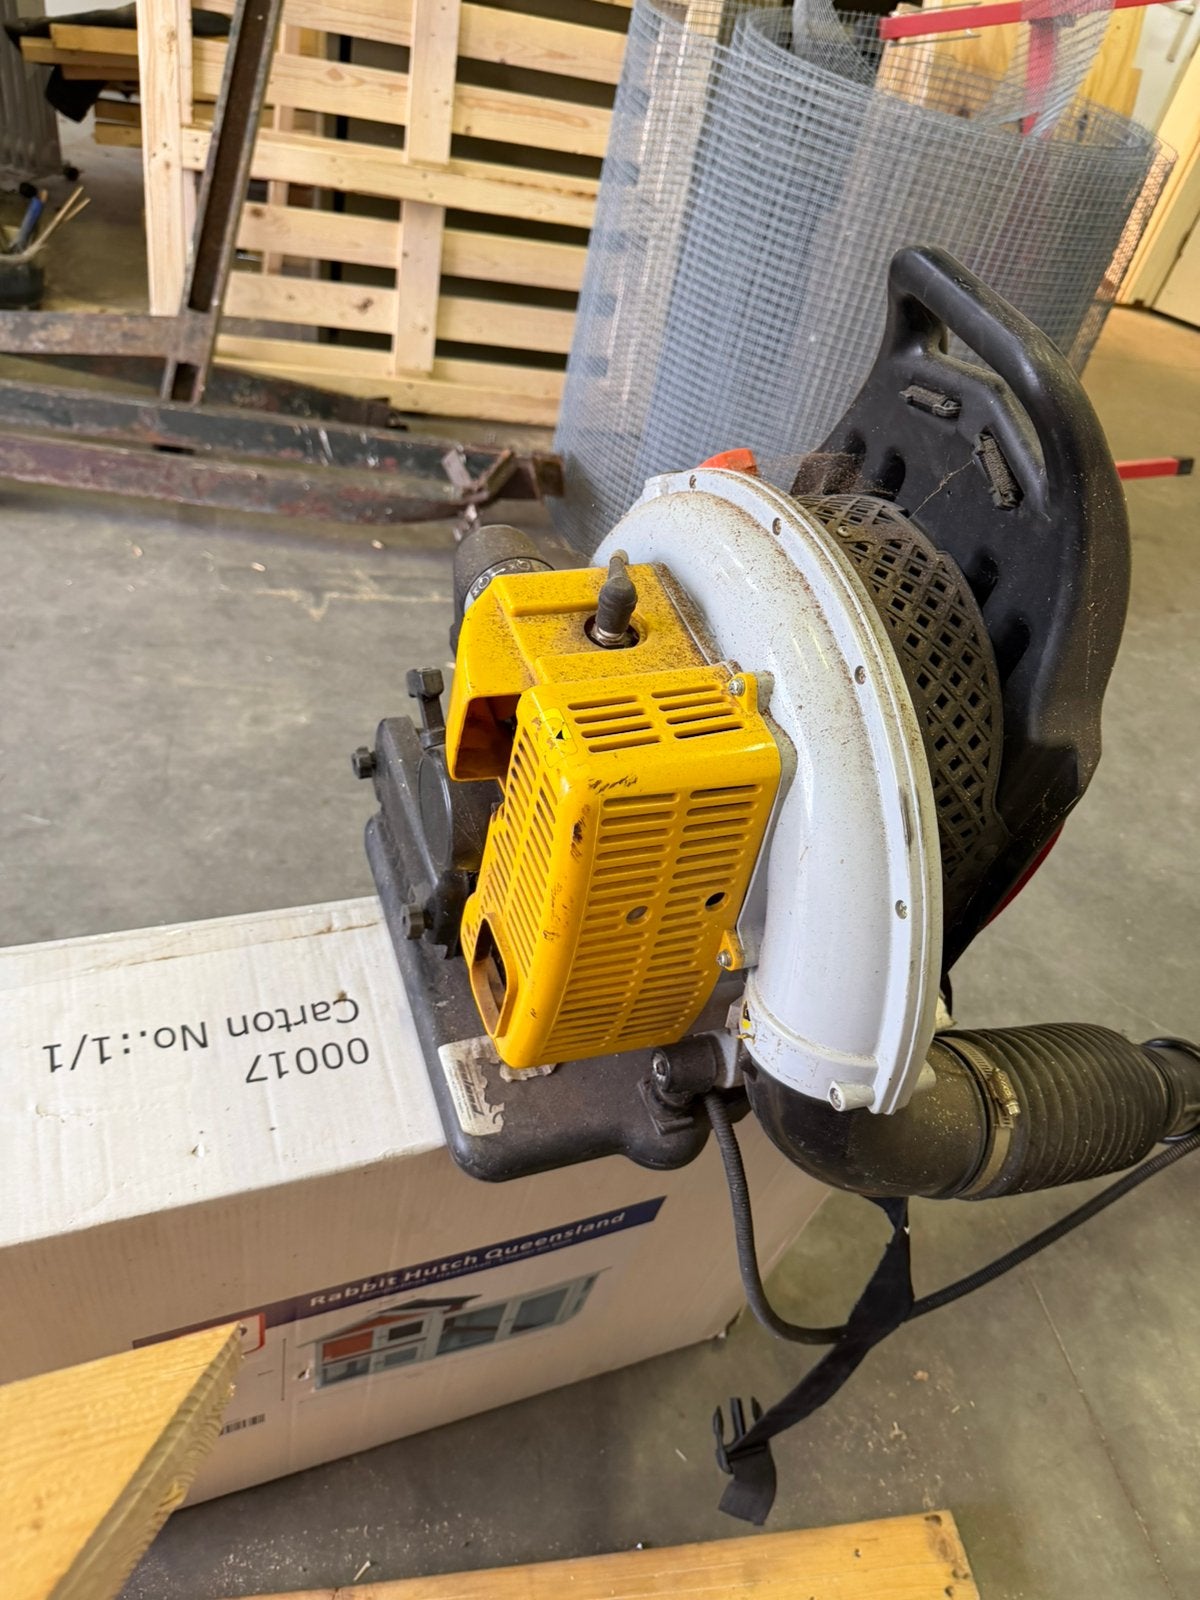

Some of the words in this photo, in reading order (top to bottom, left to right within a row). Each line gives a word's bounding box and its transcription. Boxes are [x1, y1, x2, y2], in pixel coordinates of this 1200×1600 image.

[226, 998, 359, 1037] Carton
[43, 1022, 208, 1073] No.:1/1
[245, 1037, 370, 1083] 00017
[309, 1276, 398, 1307] Rabbit
[404, 1255, 478, 1282] Hutch
[484, 1212, 625, 1260] Queensland
